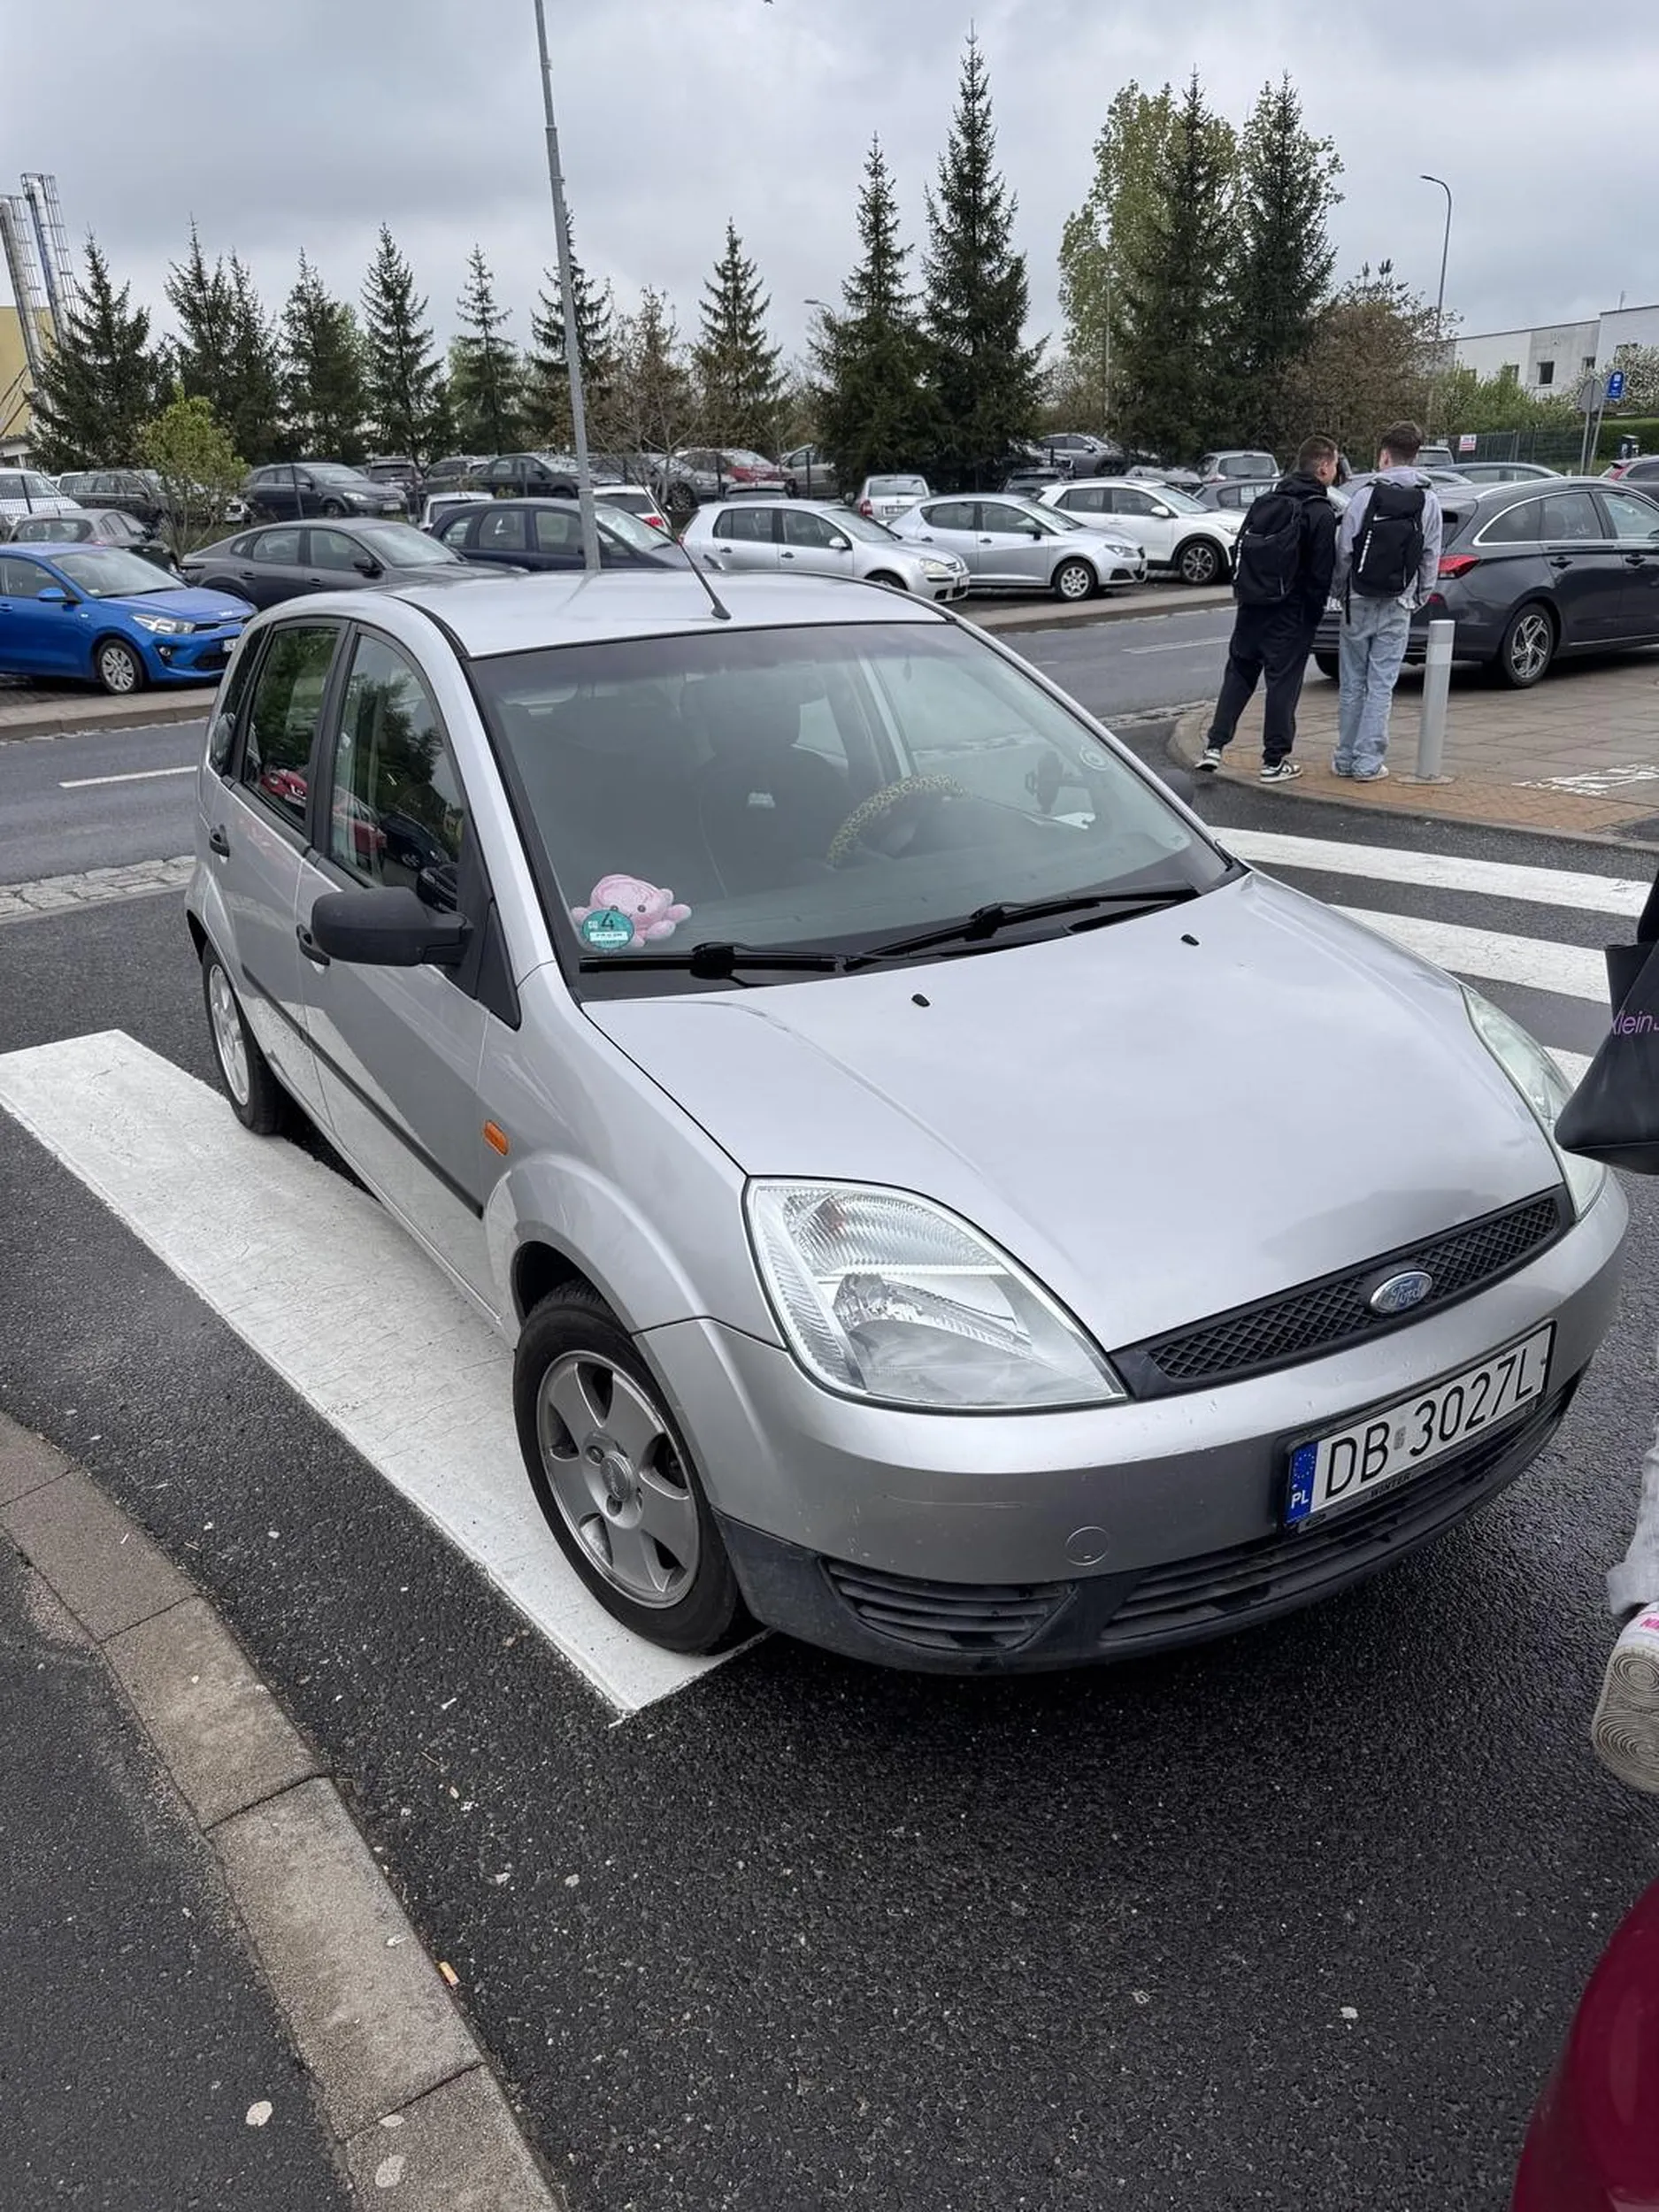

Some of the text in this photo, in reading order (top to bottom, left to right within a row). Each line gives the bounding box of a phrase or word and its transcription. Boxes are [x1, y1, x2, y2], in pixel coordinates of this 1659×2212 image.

[601, 912, 615, 930] 4
[1325, 1348, 1533, 1500] DB 3027L
[1291, 1490, 1309, 1509] PL
